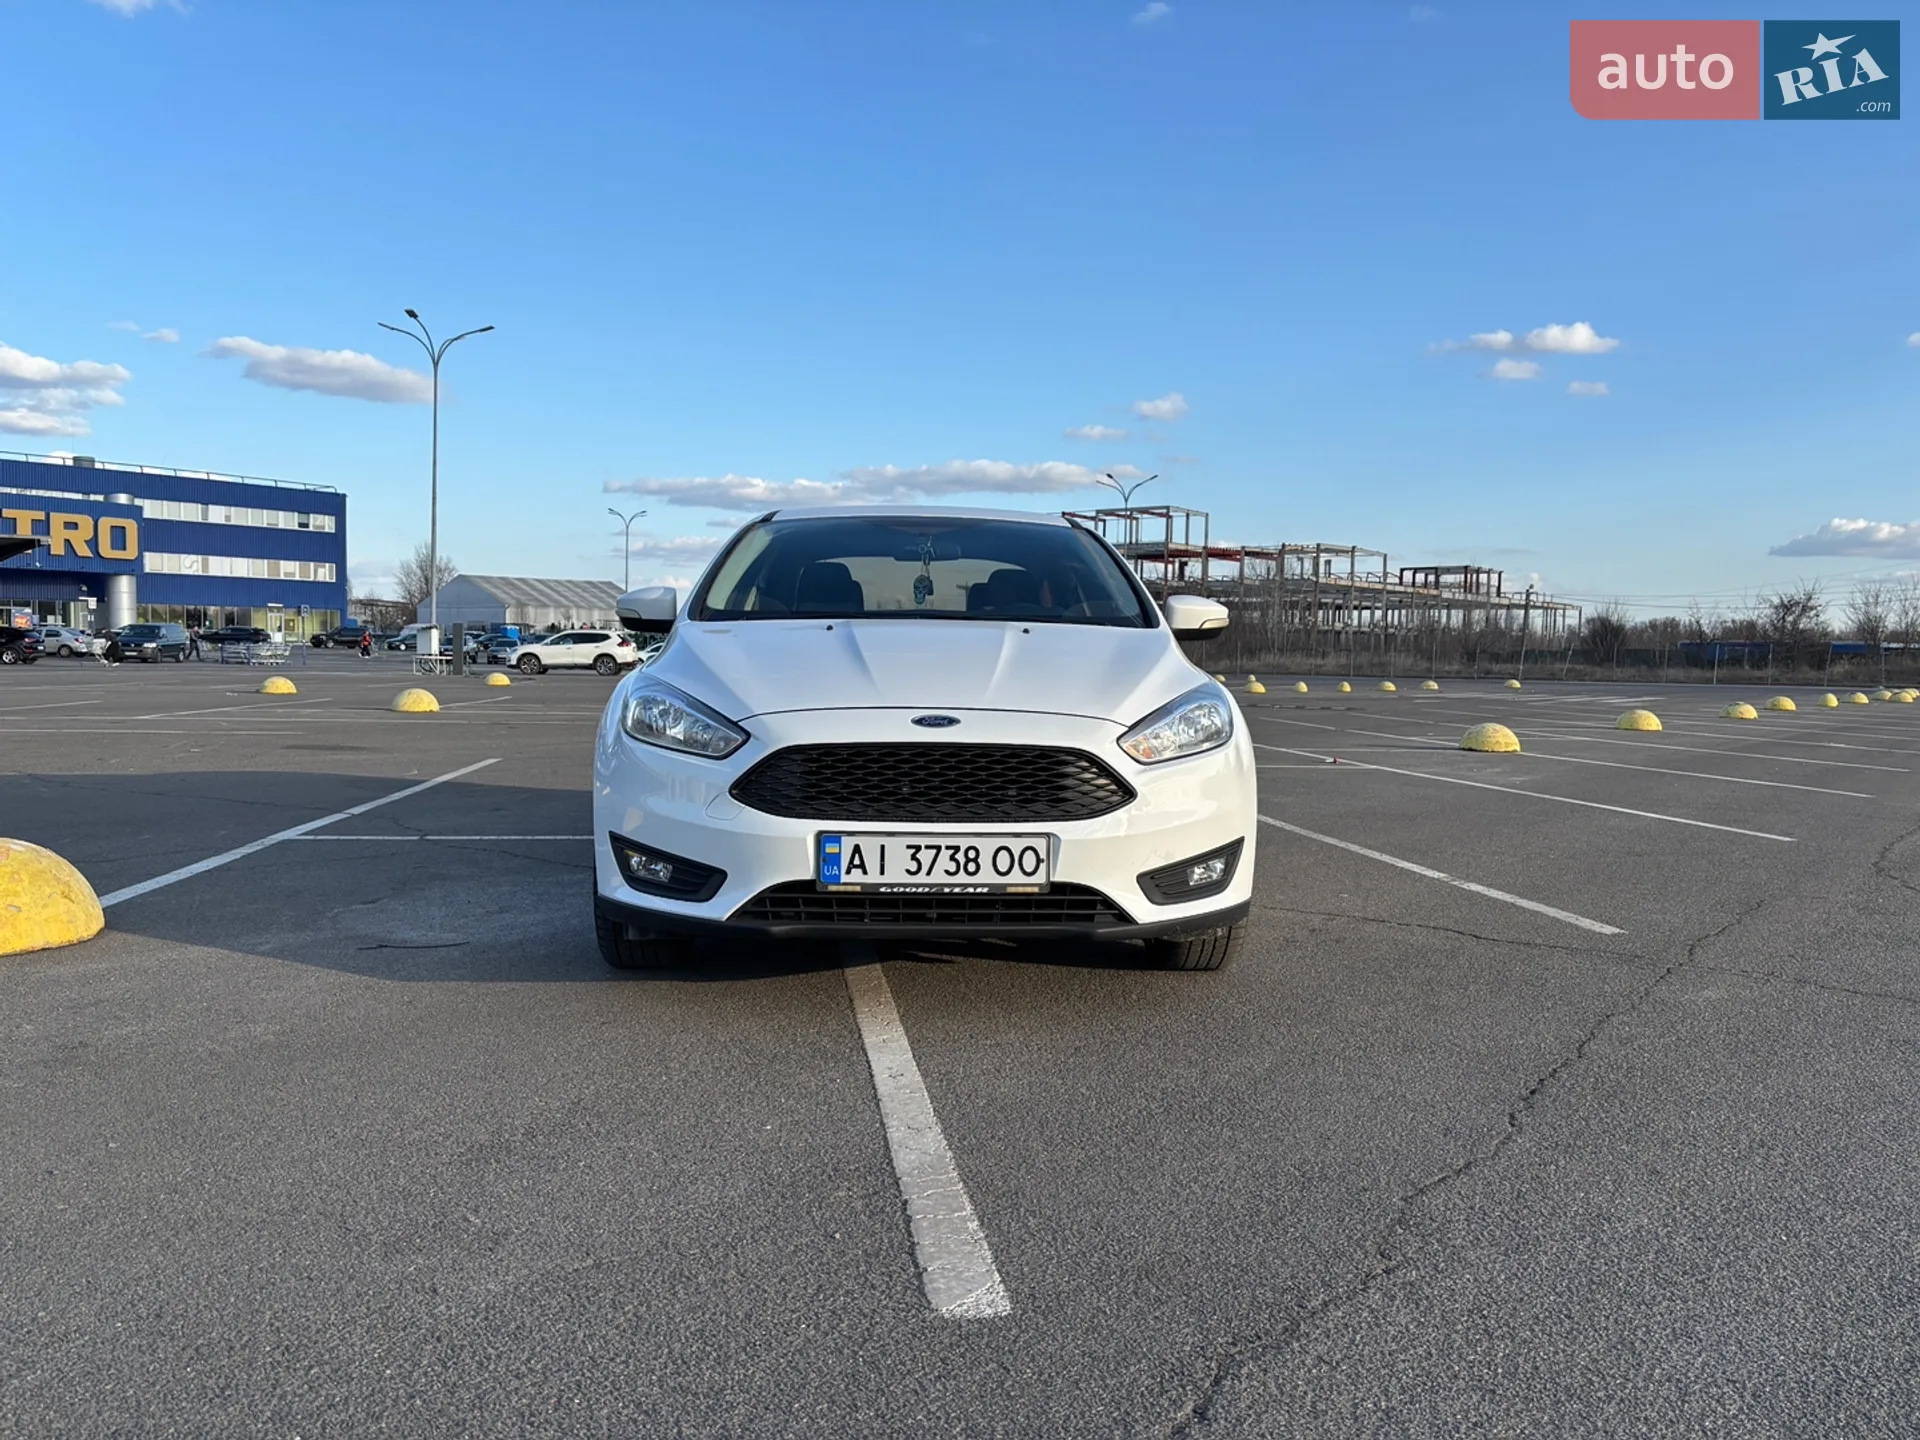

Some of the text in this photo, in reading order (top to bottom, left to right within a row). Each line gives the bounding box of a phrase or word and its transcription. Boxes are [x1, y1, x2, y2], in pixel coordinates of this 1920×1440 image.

[824, 865, 839, 876] UA
[845, 843, 1041, 877] AI 3738 OO
